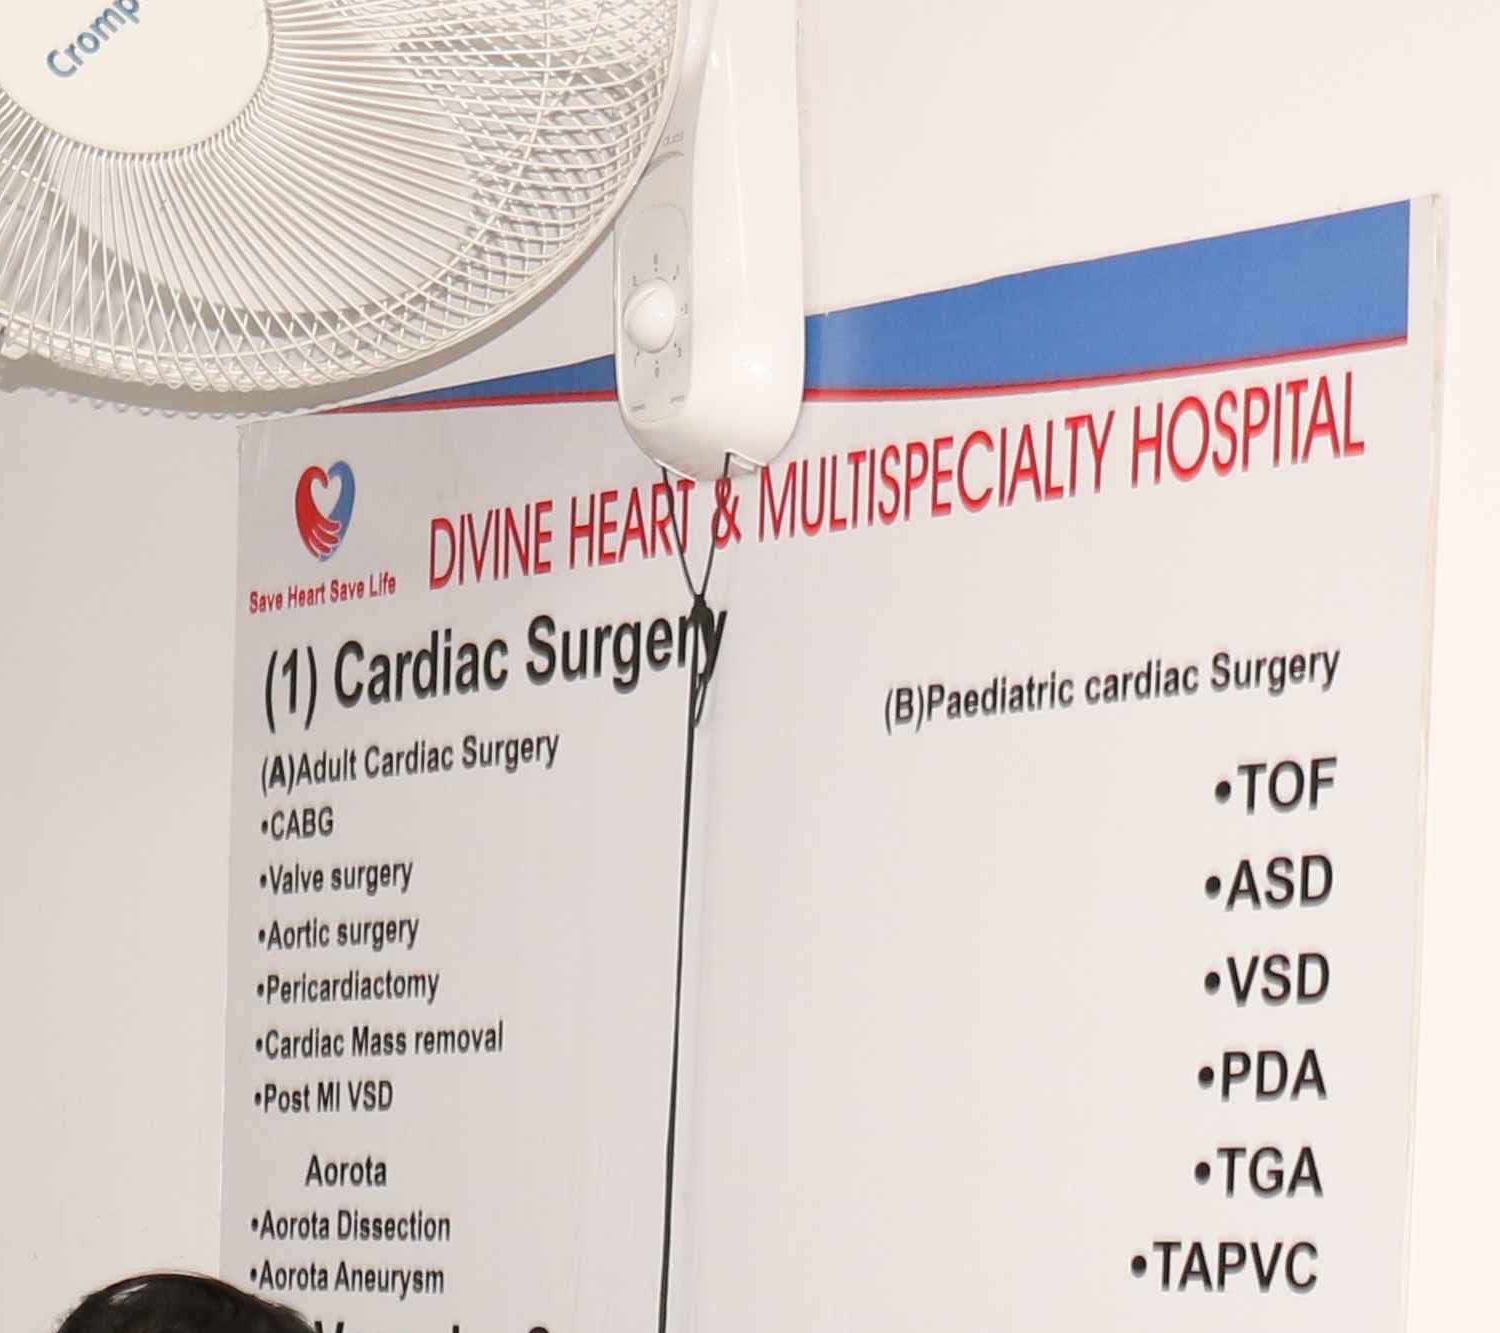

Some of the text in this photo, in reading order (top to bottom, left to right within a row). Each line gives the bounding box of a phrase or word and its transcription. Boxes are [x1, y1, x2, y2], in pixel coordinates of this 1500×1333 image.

[429, 371, 1366, 590] DIVINE HEART & MULTISPECIALTY HOSPITAL
[249, 571, 397, 614] Save Heart Save Life
[264, 610, 728, 733] (1) Cardiac Surgery
[883, 648, 1341, 735] (B)Paediatric cardiac Surgery
[261, 734, 559, 797] (A)Adult Cardiac Surgery
[331, 862, 413, 896] surgery
[337, 918, 419, 951] surgery
[352, 1026, 407, 1057] Mass
[414, 1020, 504, 1055] removal
[317, 1082, 341, 1112] MI
[348, 1080, 394, 1112] VSD
[305, 1154, 387, 1187] Aorota
[337, 1209, 451, 1241] Dissection
[335, 1261, 444, 1300] Aneurysm
